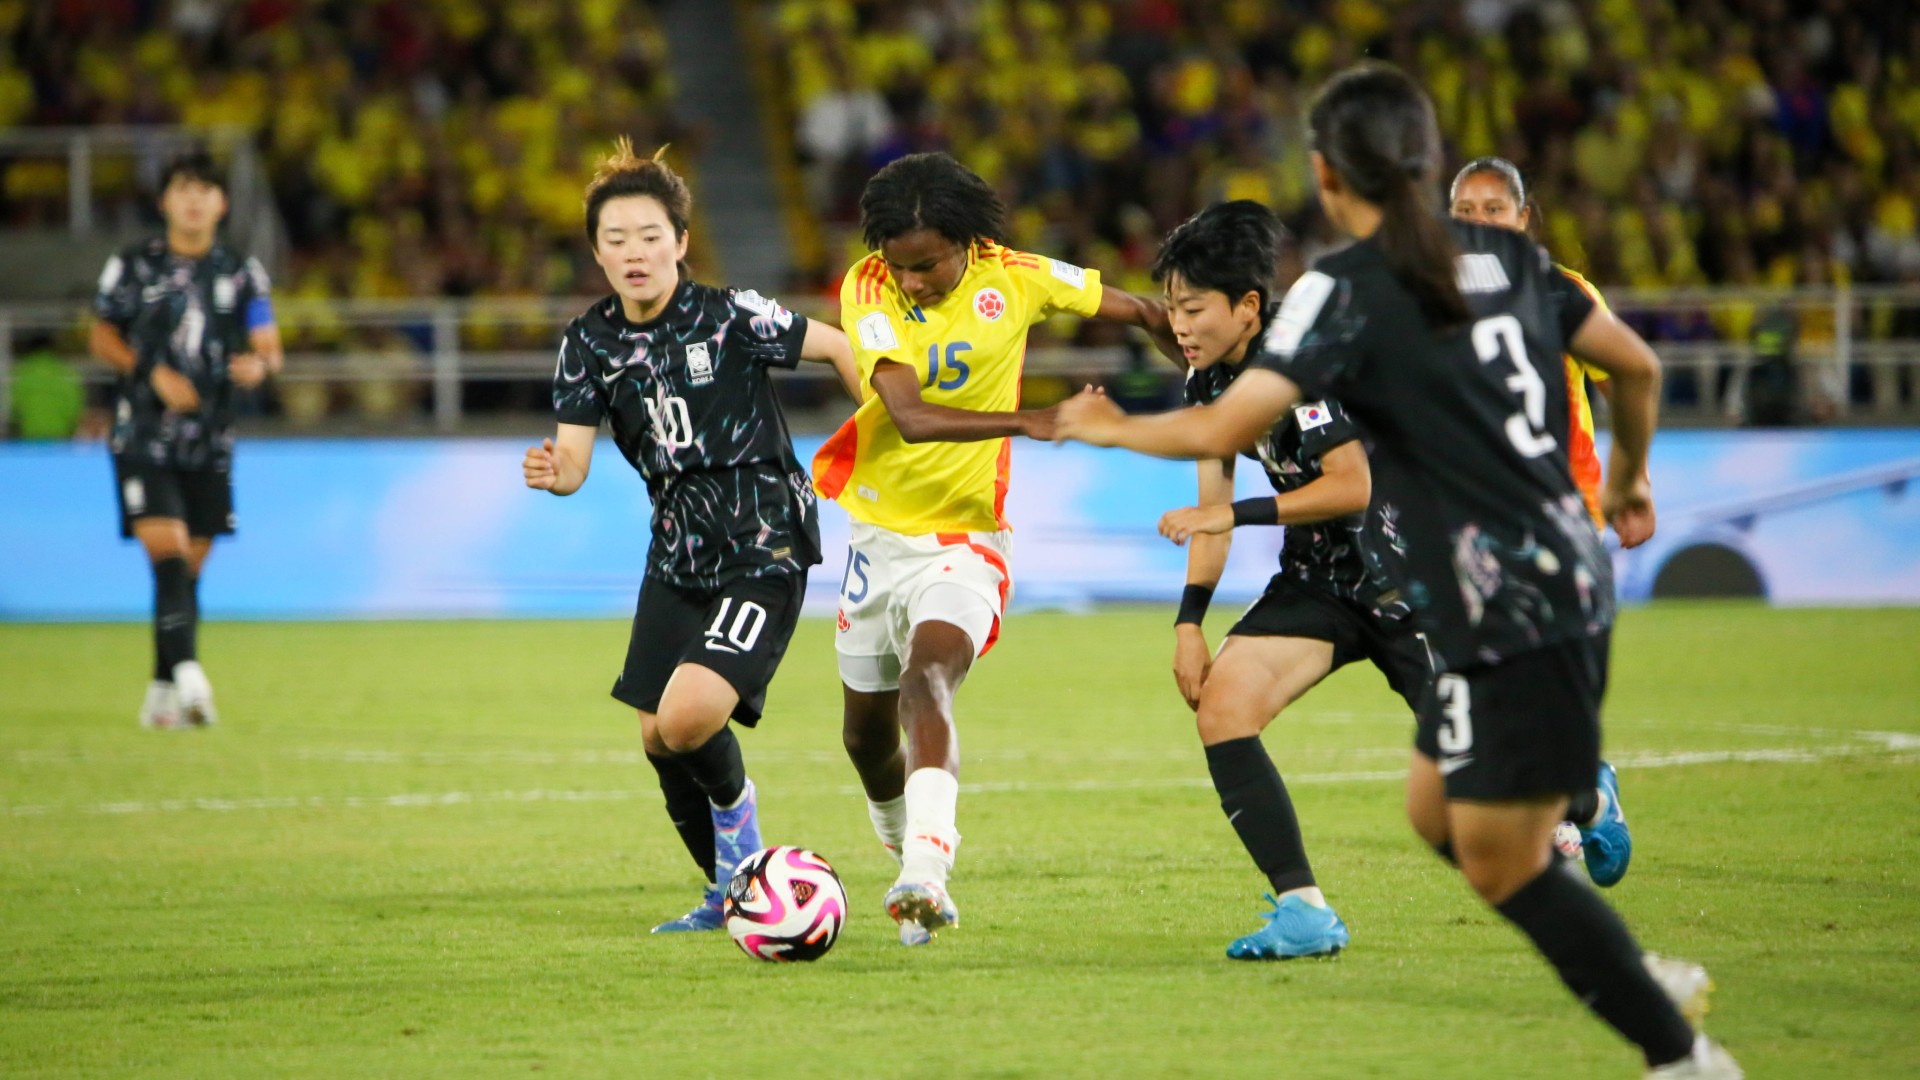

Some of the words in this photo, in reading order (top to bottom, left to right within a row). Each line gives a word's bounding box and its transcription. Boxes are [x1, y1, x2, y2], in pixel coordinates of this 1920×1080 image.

[691, 375, 715, 385] KOREA
[926, 341, 973, 390] 15
[1471, 315, 1558, 458] 3
[643, 397, 693, 448] 10
[840, 544, 871, 604] 15
[704, 597, 767, 652] 10
[1436, 672, 1474, 755] 3
